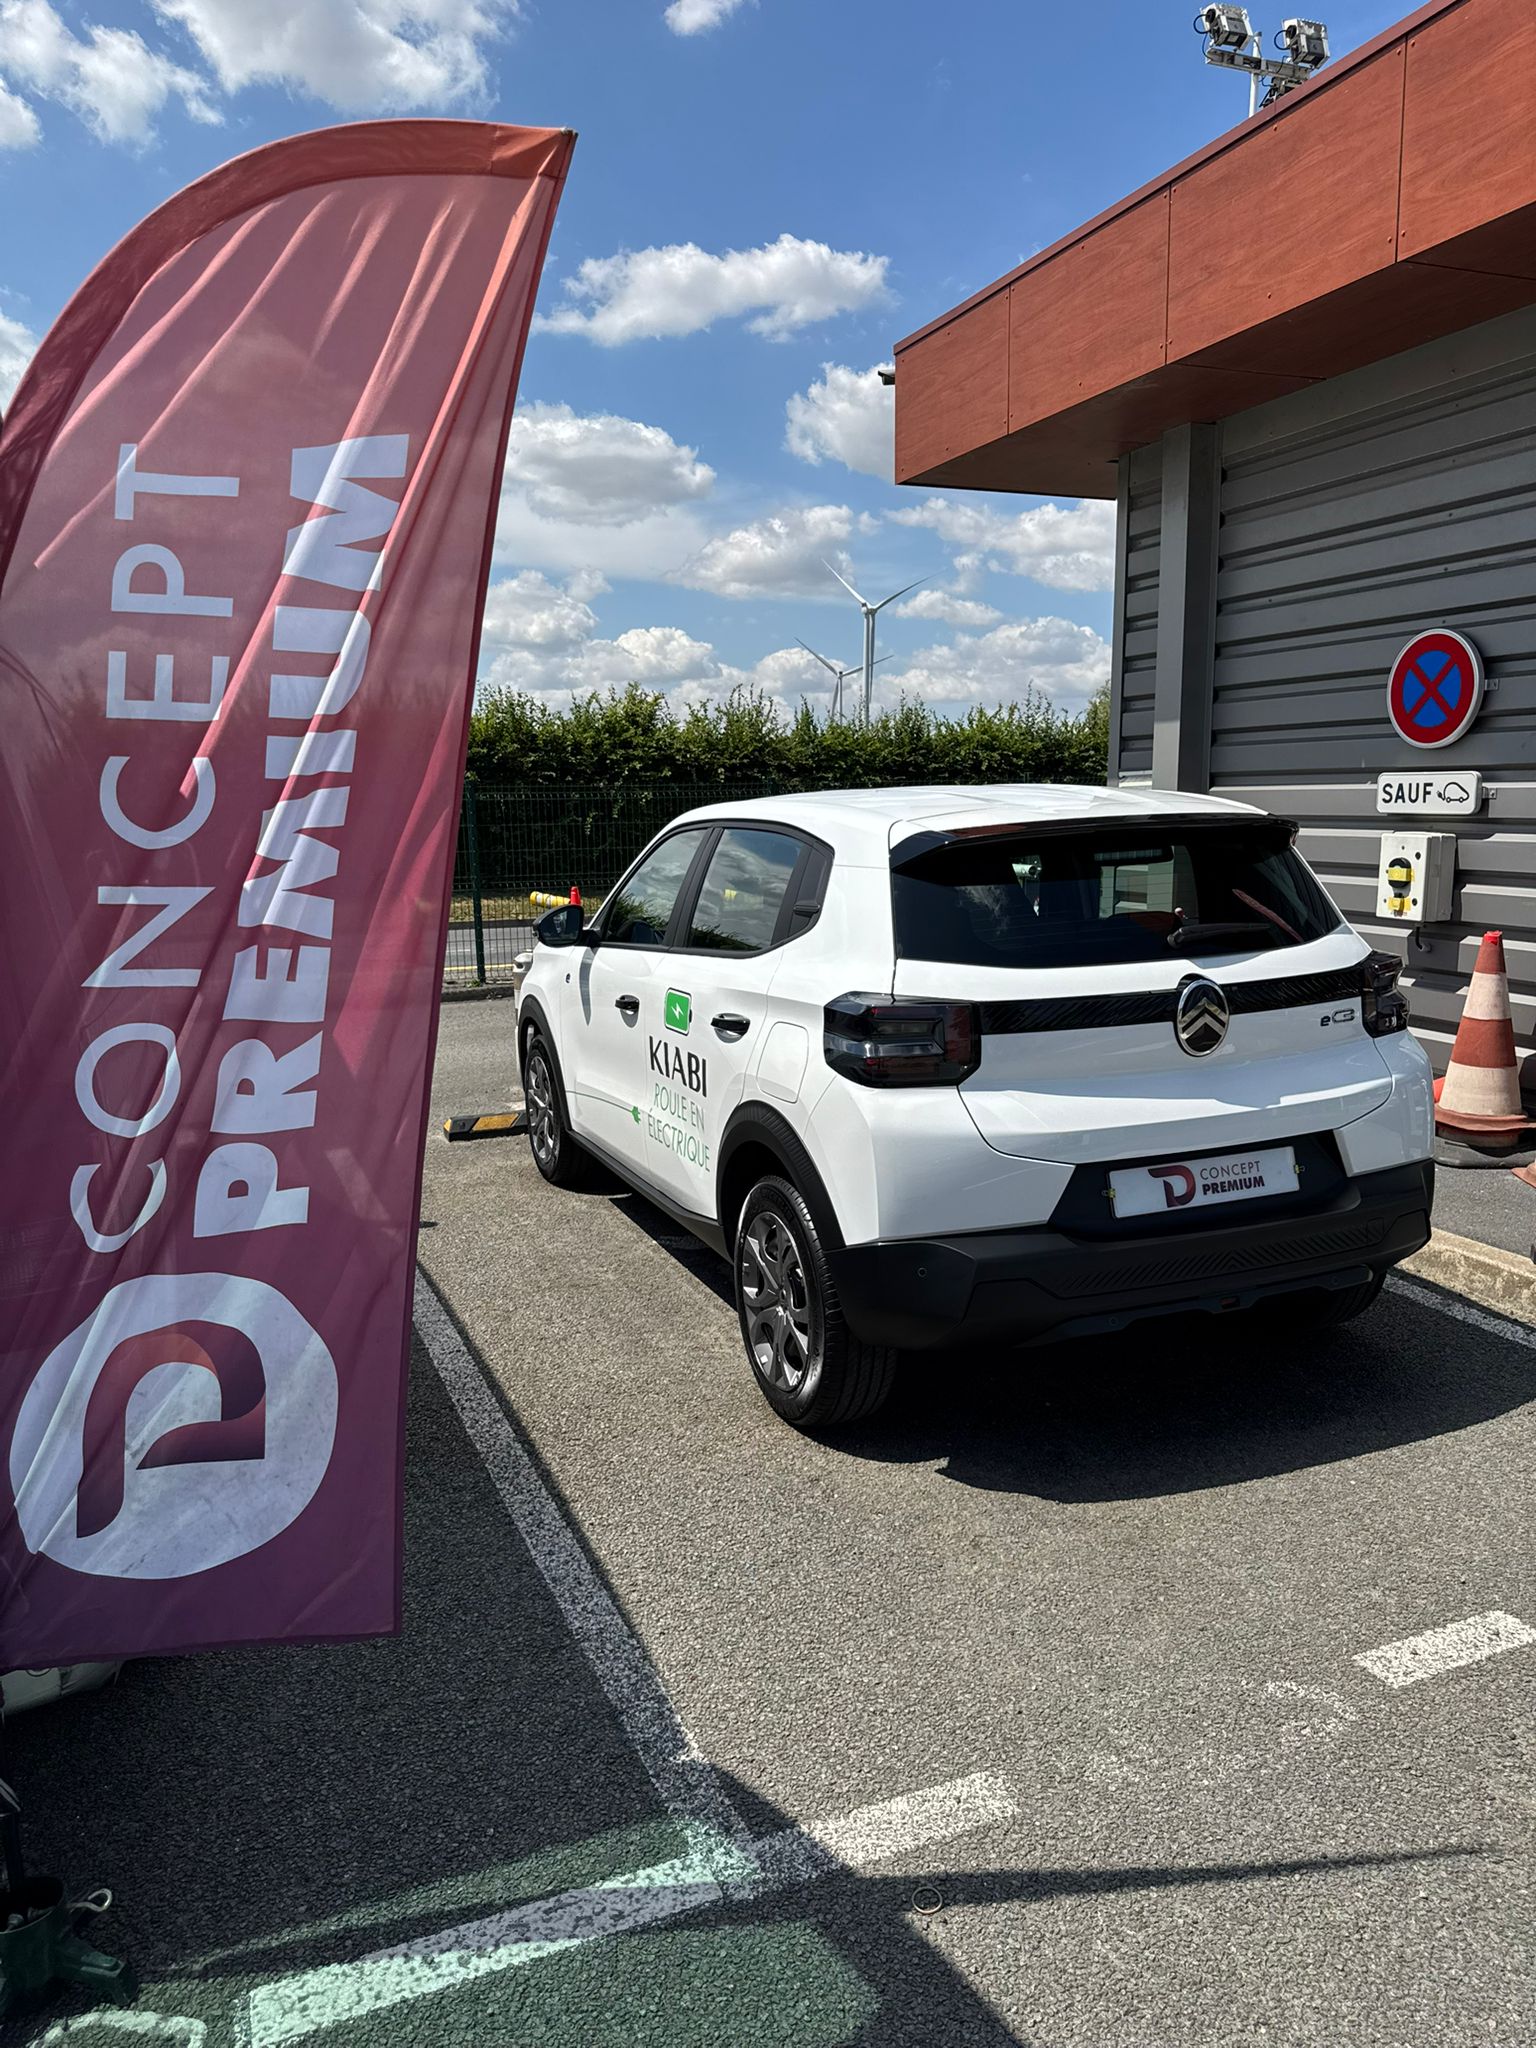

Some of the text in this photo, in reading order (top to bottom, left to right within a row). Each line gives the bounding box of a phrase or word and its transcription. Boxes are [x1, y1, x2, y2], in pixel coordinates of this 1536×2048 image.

[1381, 782, 1434, 804] SAUF
[70, 443, 240, 1252] CONCEPT
[193, 434, 409, 1238] PREMIUM
[649, 1035, 707, 1098] KIABI
[653, 1083, 705, 1134] ROULE EN
[647, 1107, 711, 1172] ÉLECTRIQUE
[1199, 1160, 1261, 1181] CONCEPT
[1202, 1175, 1265, 1196] PREMIUM
